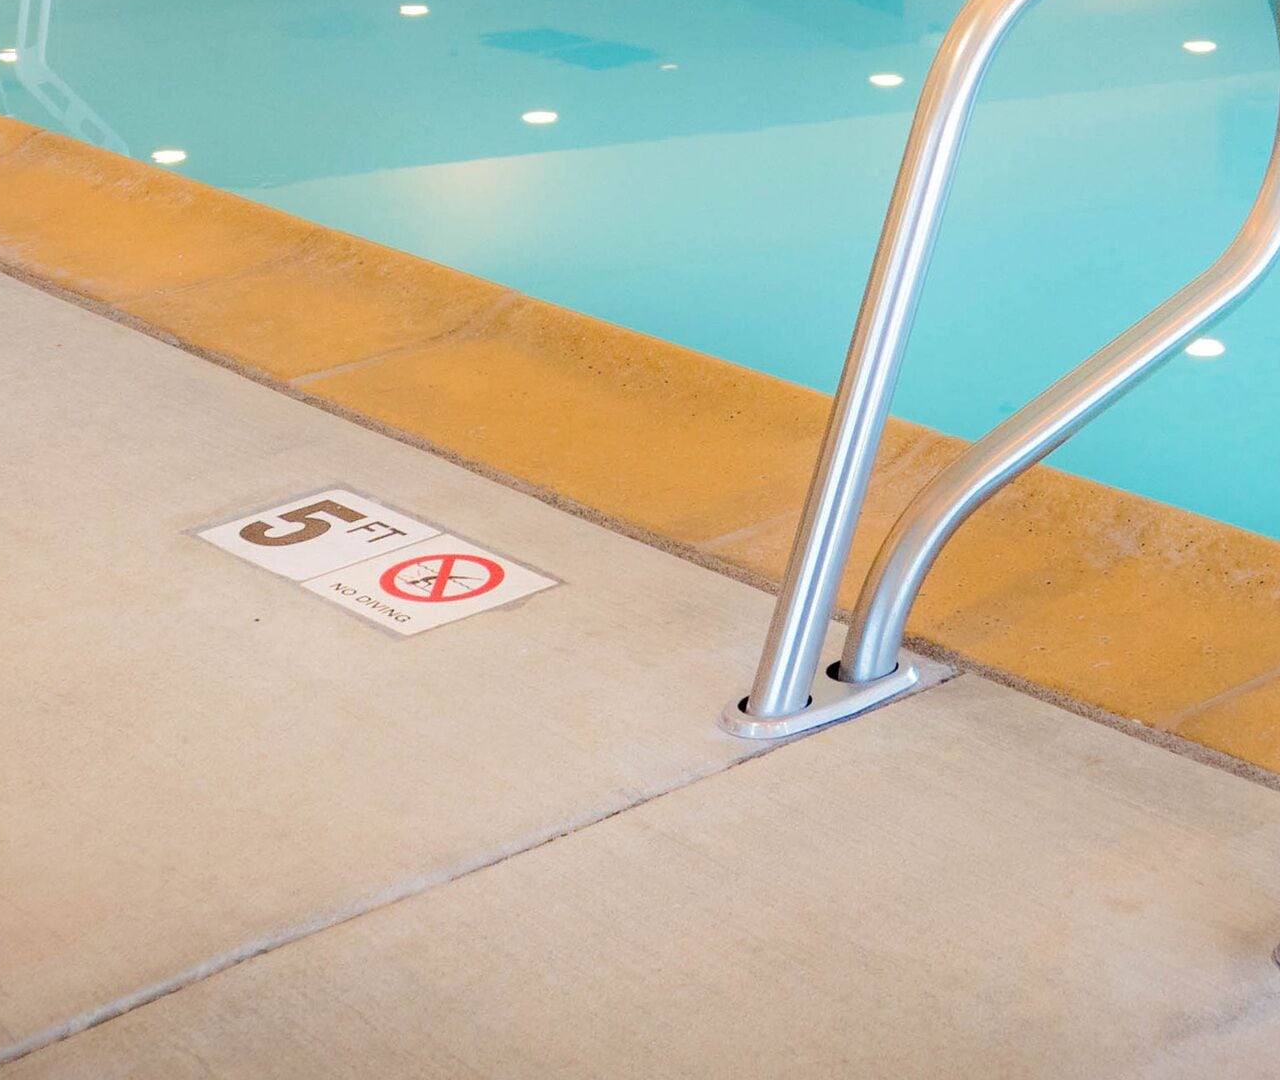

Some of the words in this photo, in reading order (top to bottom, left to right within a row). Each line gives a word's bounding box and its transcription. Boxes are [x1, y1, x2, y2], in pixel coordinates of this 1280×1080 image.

[239, 498, 368, 548] 5
[346, 520, 408, 543] FT
[329, 582, 357, 596] NO
[356, 595, 411, 623] DIVING
